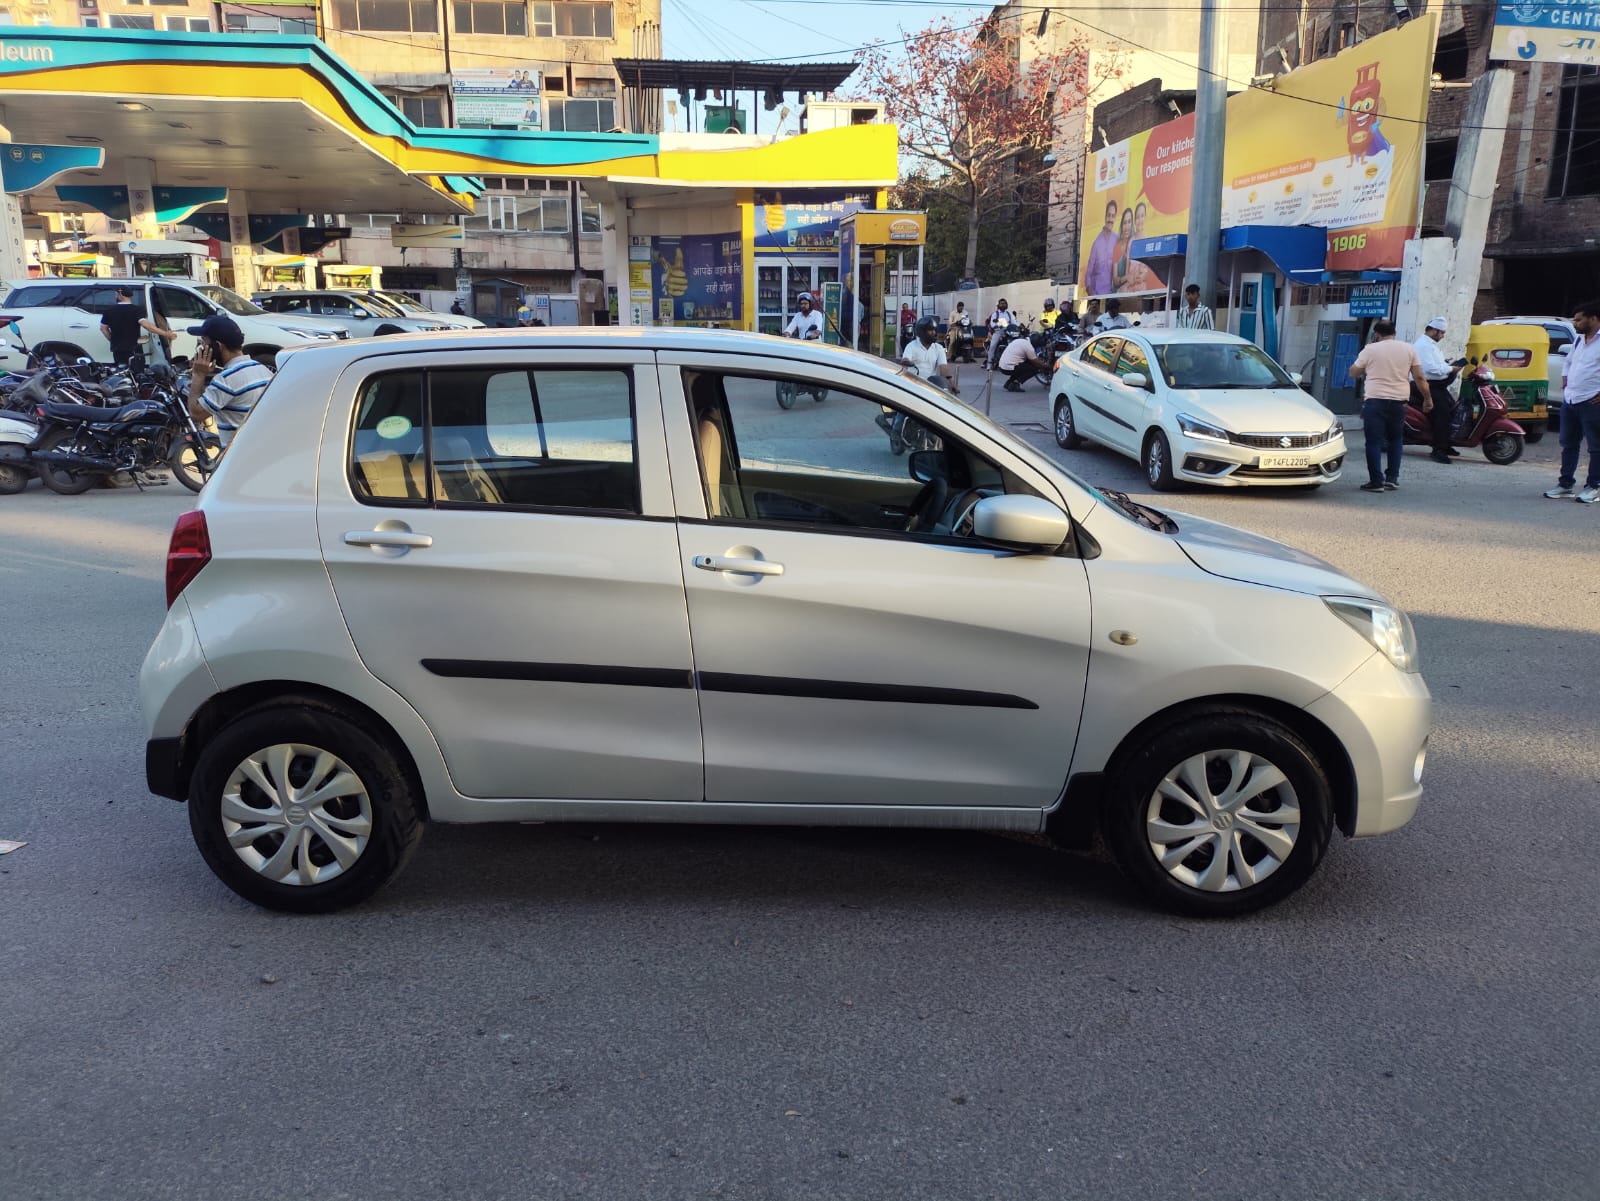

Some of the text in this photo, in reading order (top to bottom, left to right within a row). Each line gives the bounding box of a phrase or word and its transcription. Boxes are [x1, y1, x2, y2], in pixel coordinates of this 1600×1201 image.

[1156, 146, 1170, 159] Our
[1145, 165, 1159, 178] Our
[1332, 233, 1367, 253] 1906
[1352, 284, 1388, 297] NITROGEN
